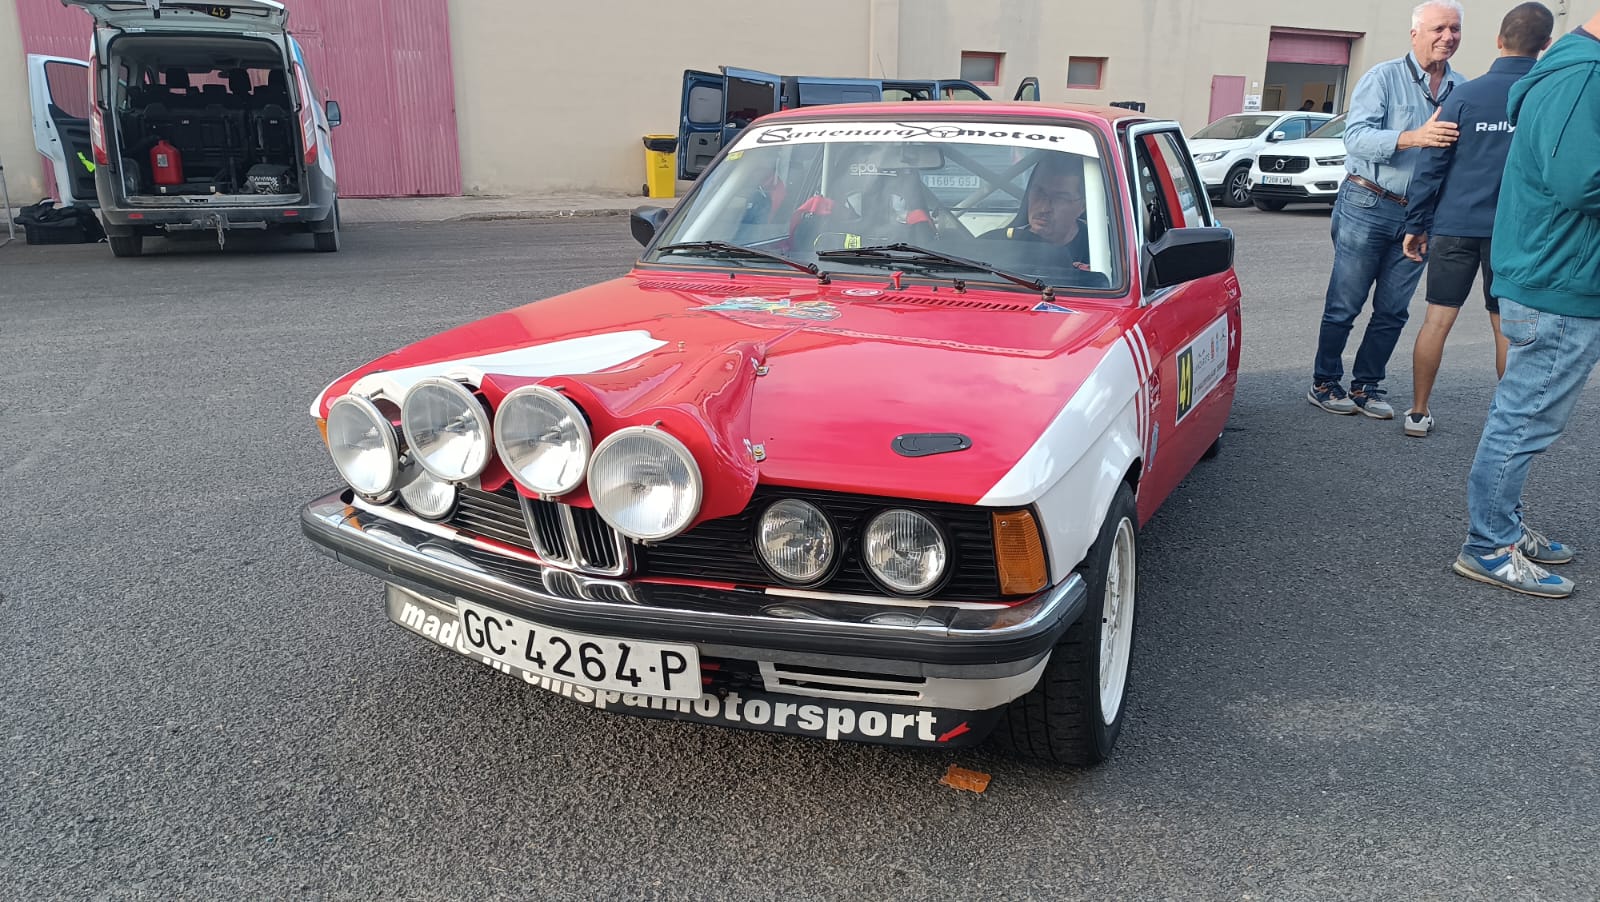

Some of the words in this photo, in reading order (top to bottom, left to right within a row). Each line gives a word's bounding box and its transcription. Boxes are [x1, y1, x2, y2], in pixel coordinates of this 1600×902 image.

[1475, 121, 1516, 133] Rally
[958, 129, 1065, 142] motor
[850, 163, 897, 177] spa
